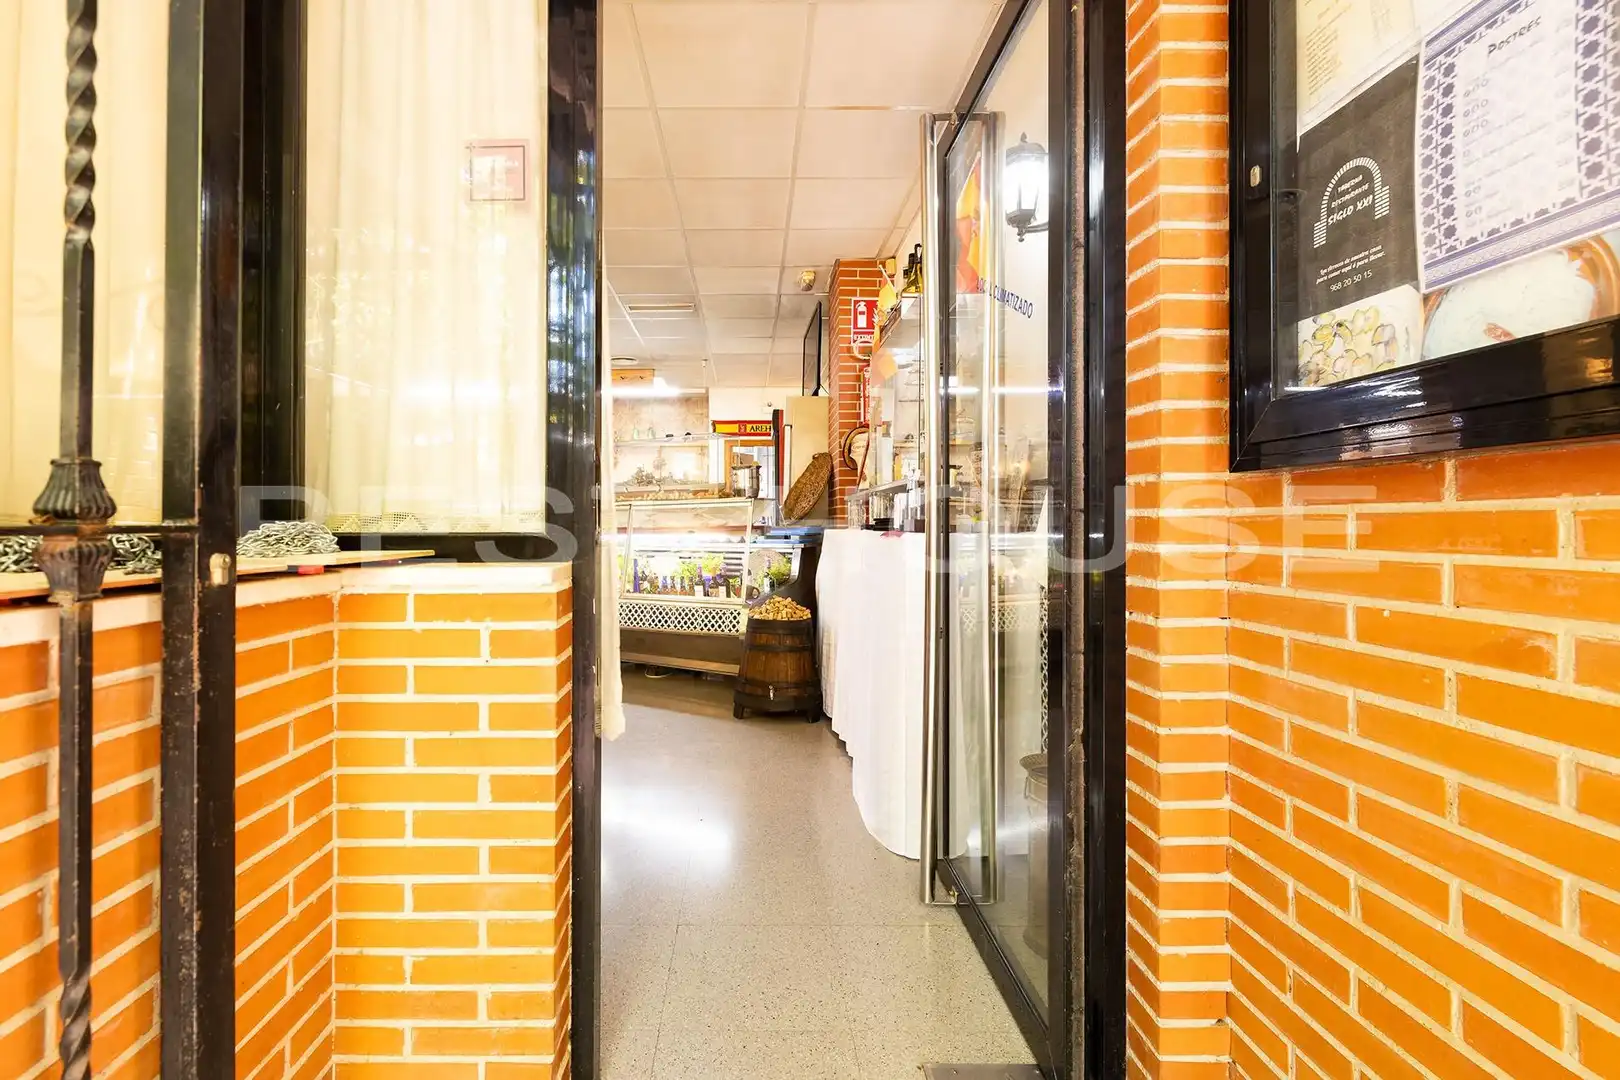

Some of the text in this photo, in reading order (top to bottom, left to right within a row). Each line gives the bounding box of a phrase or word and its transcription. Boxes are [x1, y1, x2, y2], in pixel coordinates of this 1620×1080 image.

[1487, 15, 1542, 55] POSTRES
[1327, 194, 1373, 226] SIGLO XXI
[1329, 269, 1373, 292] 968 20 50 15
